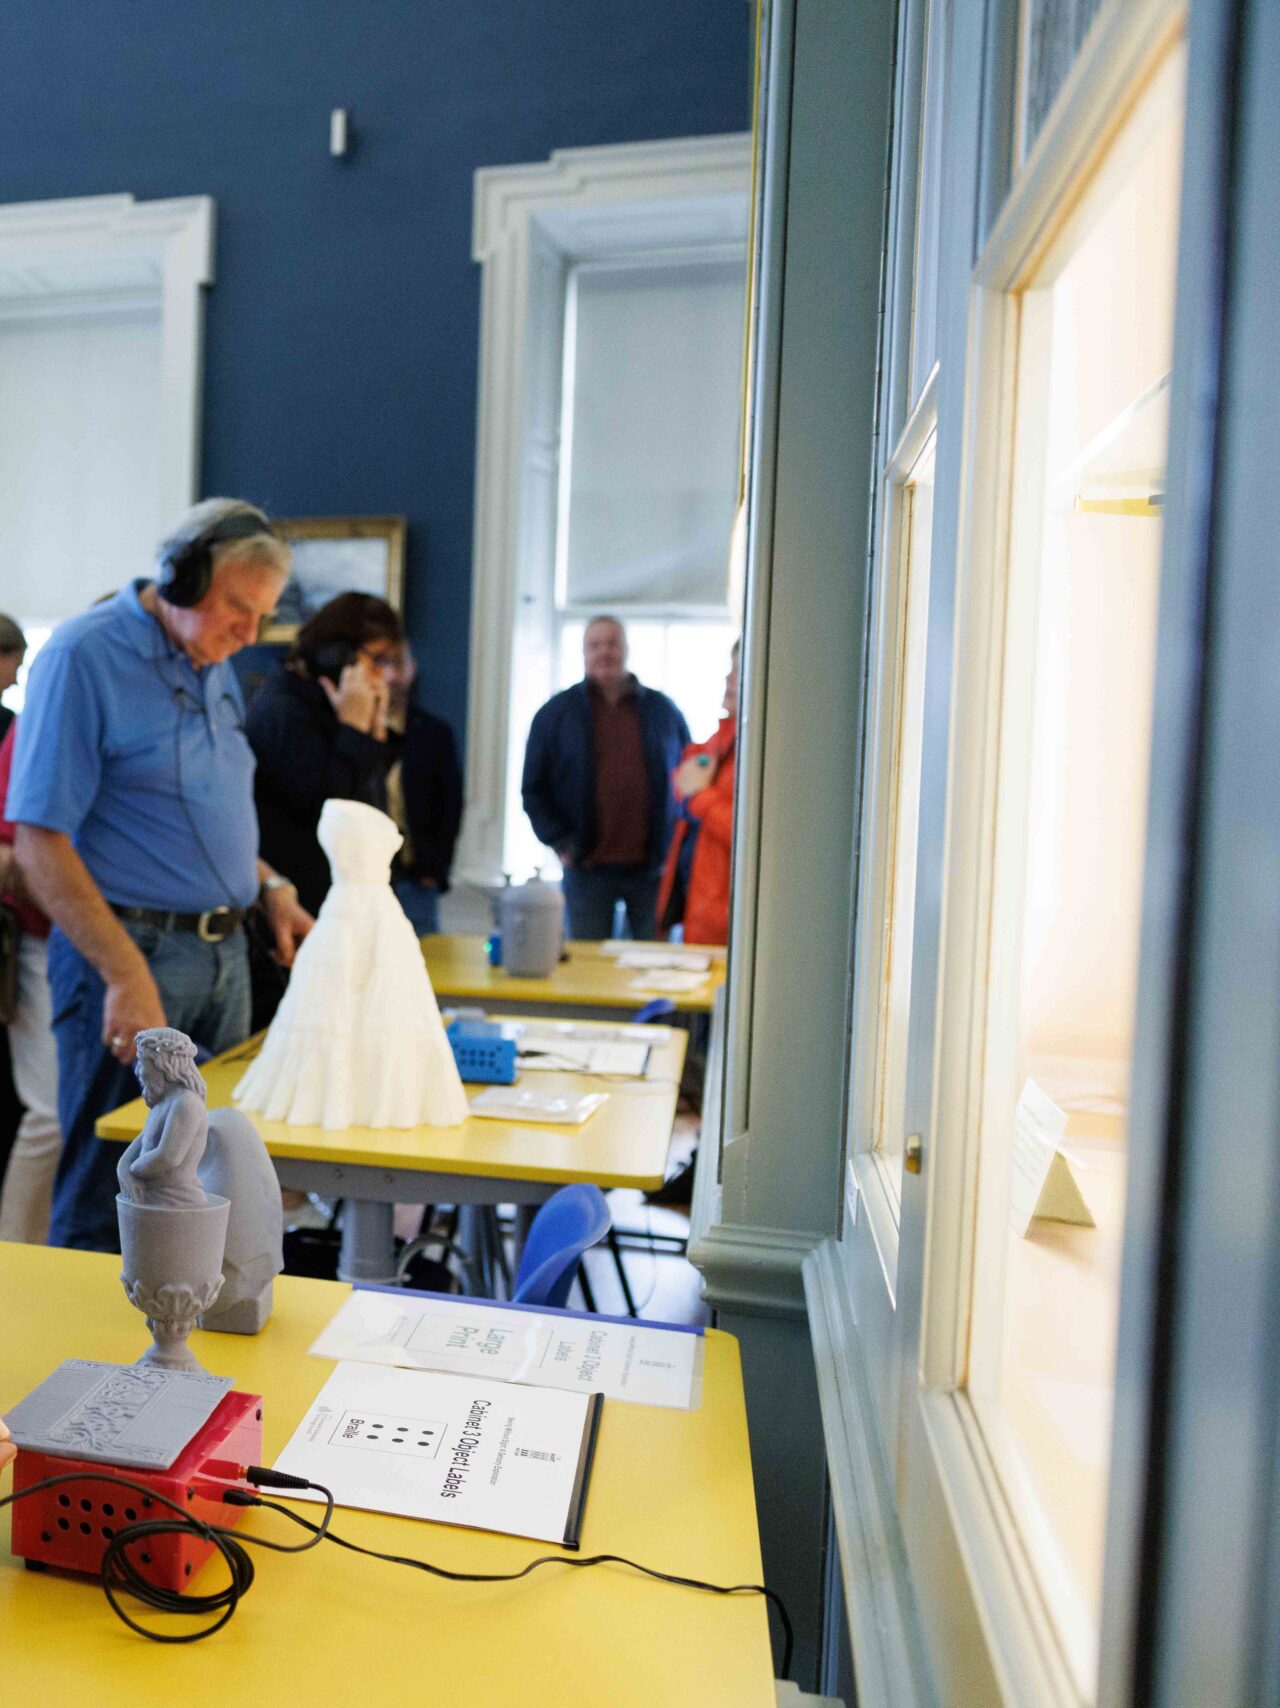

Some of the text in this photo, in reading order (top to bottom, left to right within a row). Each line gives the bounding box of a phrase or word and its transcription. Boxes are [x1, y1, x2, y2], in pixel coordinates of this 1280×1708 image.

[445, 1325, 479, 1349] Print
[476, 1328, 515, 1355] Large
[586, 1330, 608, 1355] Cabinet
[554, 1341, 576, 1361] Labels
[576, 1360, 600, 1382] Object
[464, 1400, 492, 1430] Cabinet
[342, 1418, 365, 1439] Braille
[451, 1437, 480, 1467] Object
[440, 1467, 470, 1498] Labels
